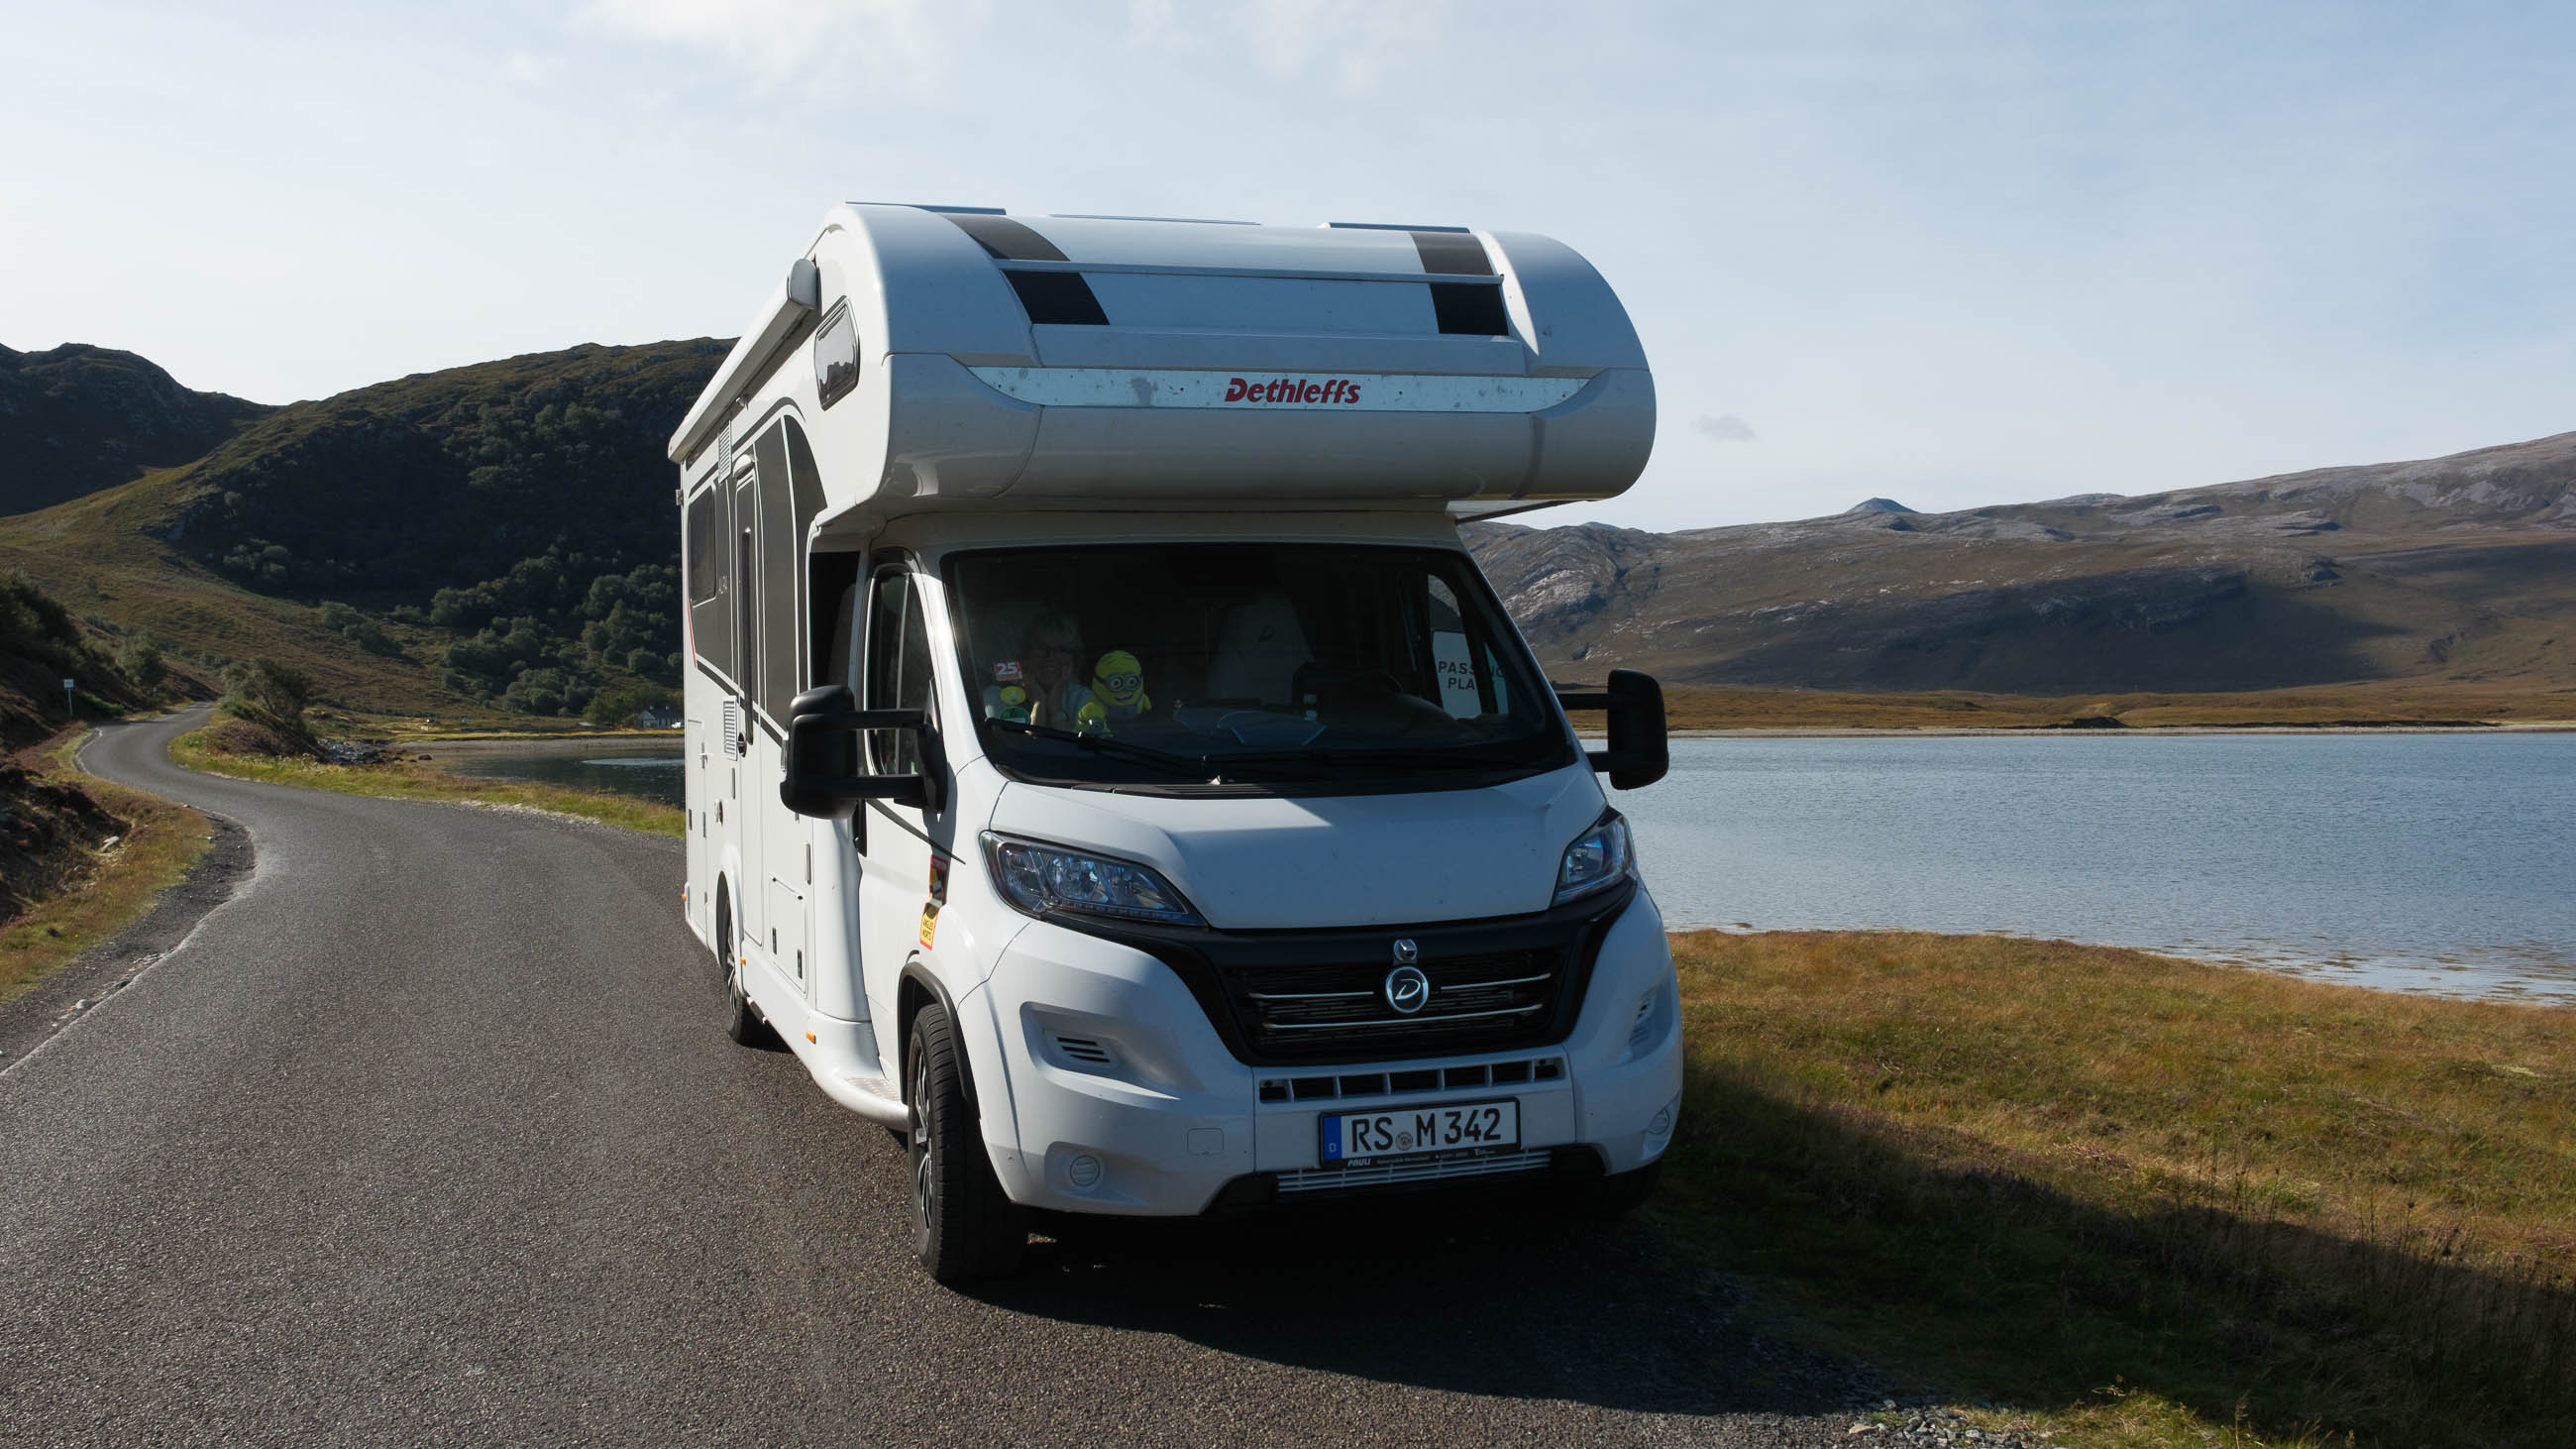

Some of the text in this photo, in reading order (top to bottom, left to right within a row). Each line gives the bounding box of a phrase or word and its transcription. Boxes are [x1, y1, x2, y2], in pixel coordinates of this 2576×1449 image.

[1225, 378, 1360, 404] Dethleffs
[998, 661, 1018, 675] 25
[1449, 677, 1474, 690] PLA
[1329, 1107, 1502, 1154] D RS M 342
